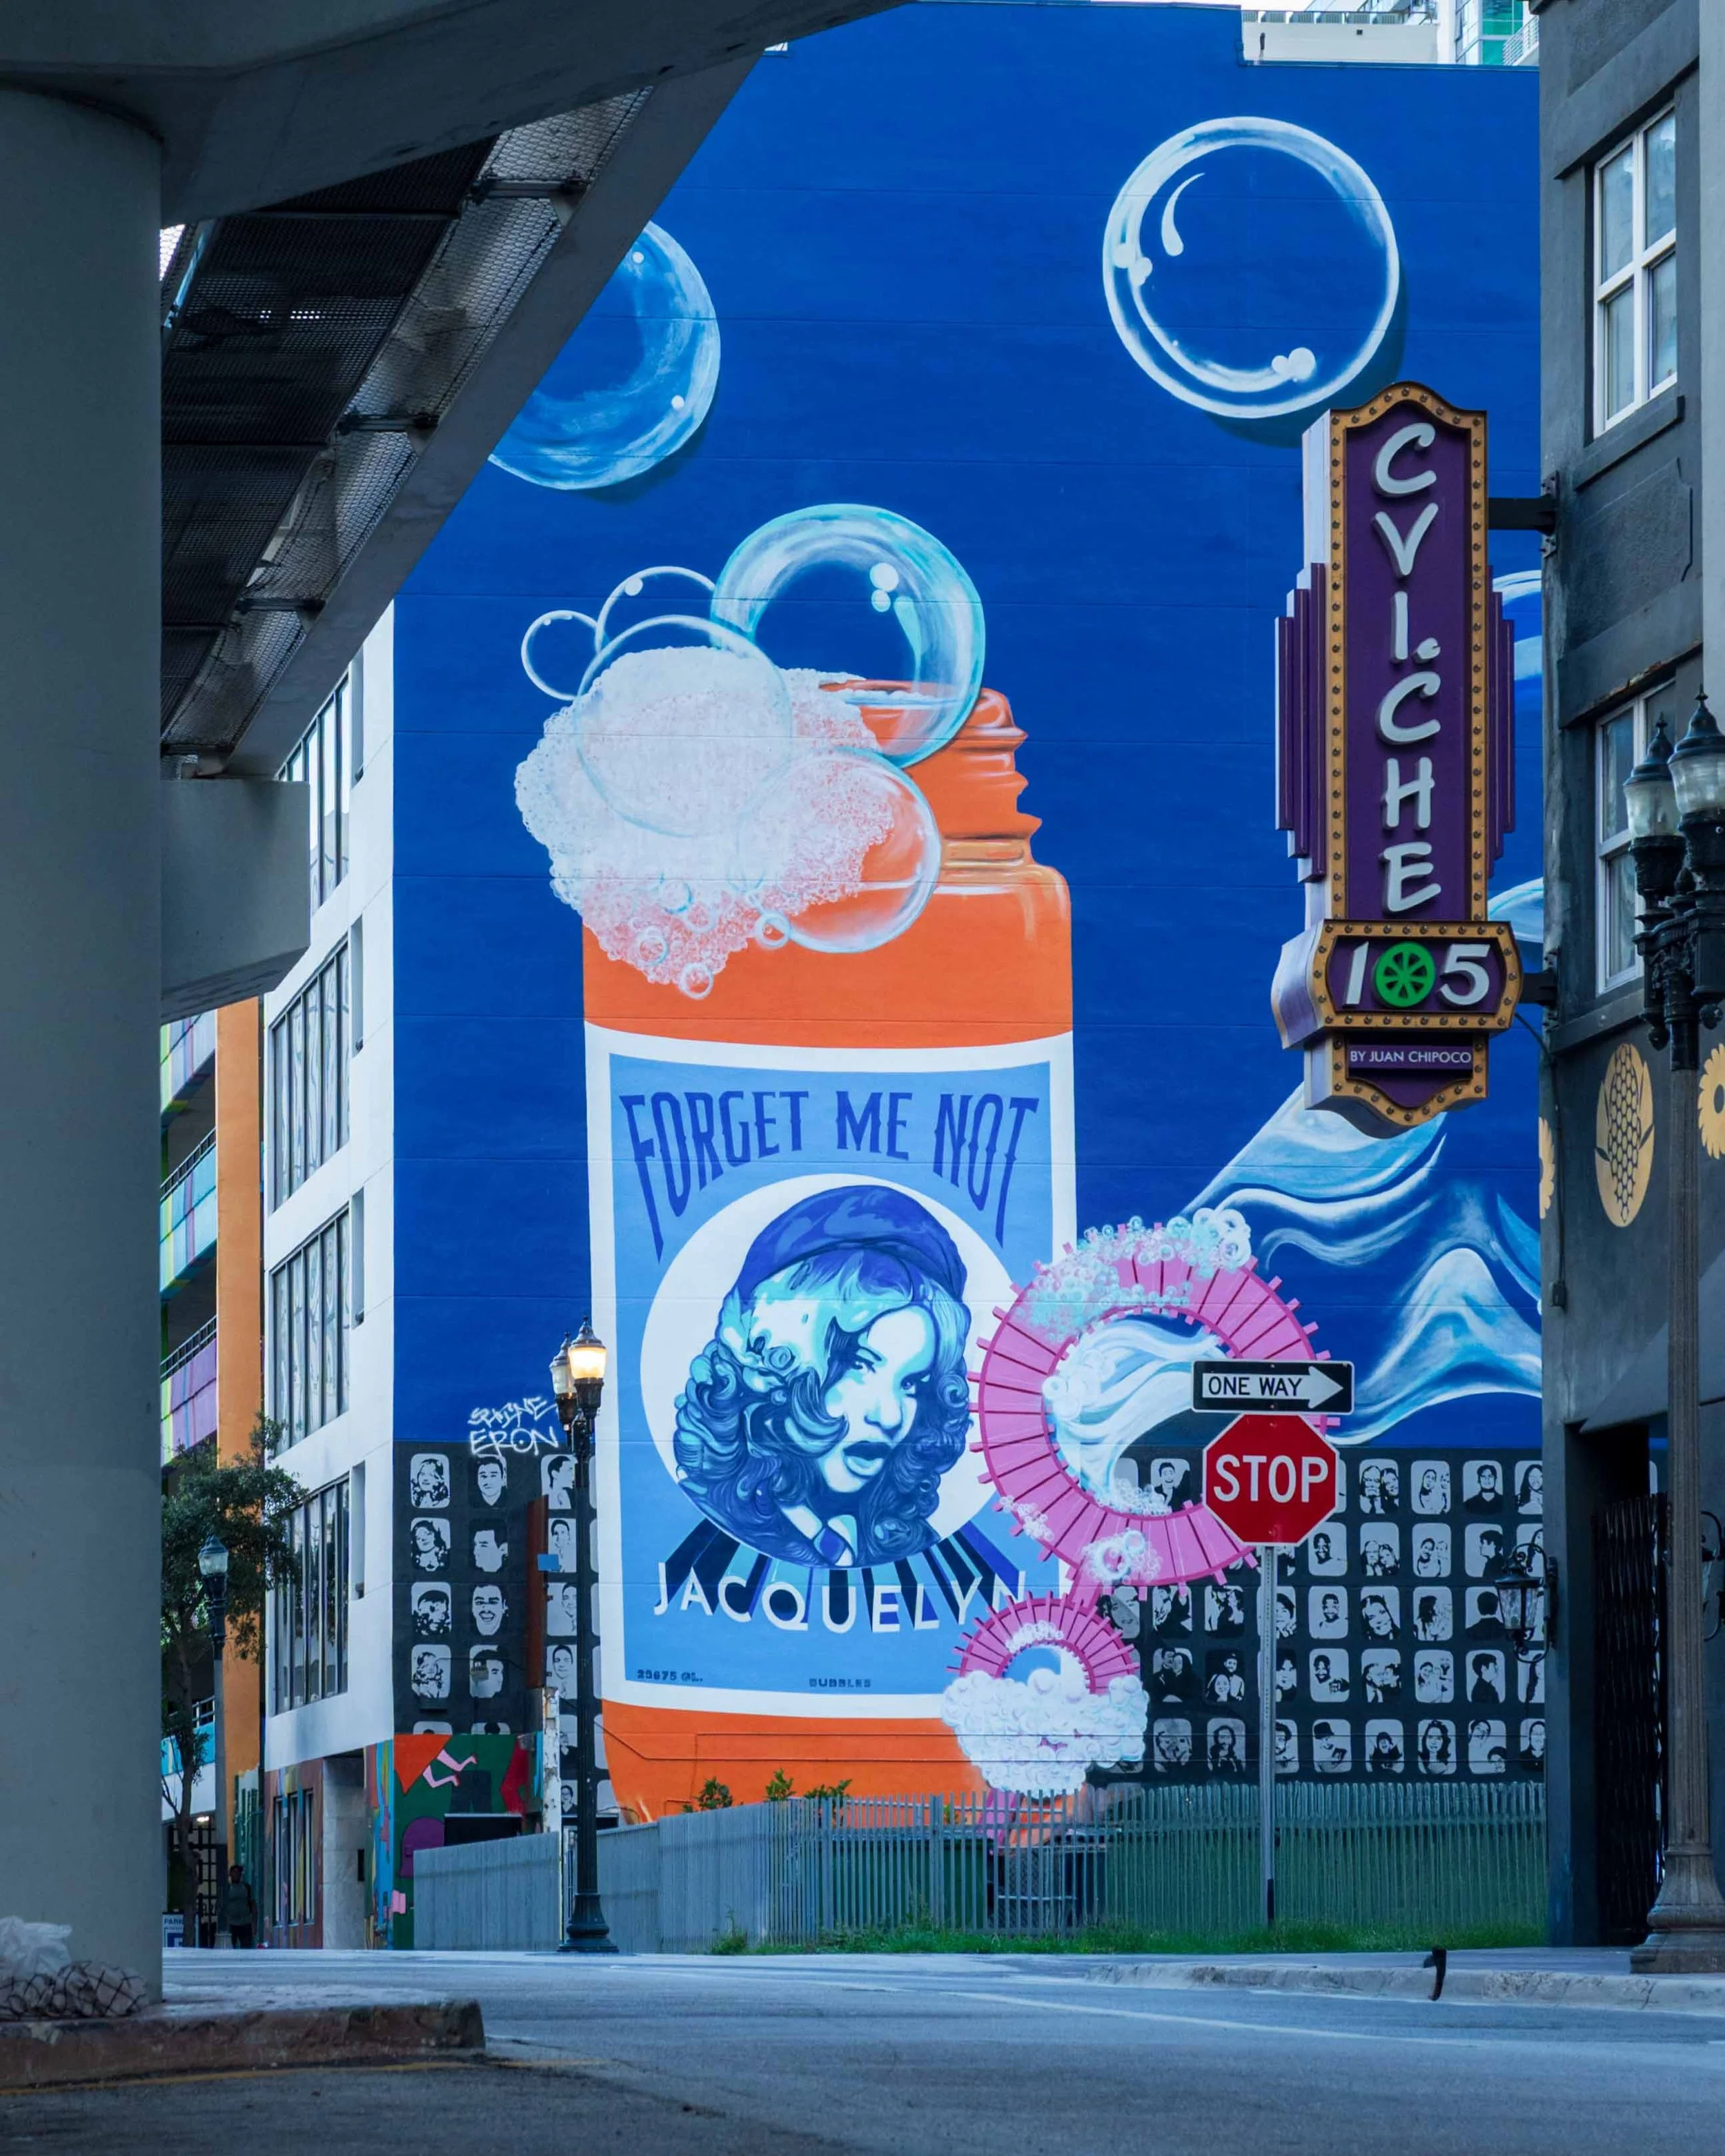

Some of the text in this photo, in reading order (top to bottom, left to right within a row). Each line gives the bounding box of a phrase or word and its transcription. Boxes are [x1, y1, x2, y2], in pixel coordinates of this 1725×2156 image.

[1350, 1051, 1472, 1063] BY JUAN CHIPOCO
[619, 1089, 1040, 1265] FORGET ME NOT
[1208, 1376, 1303, 1396] ONE WAY
[1213, 1454, 1329, 1503] STOP
[653, 1562, 1027, 1633] JACQUELYN
